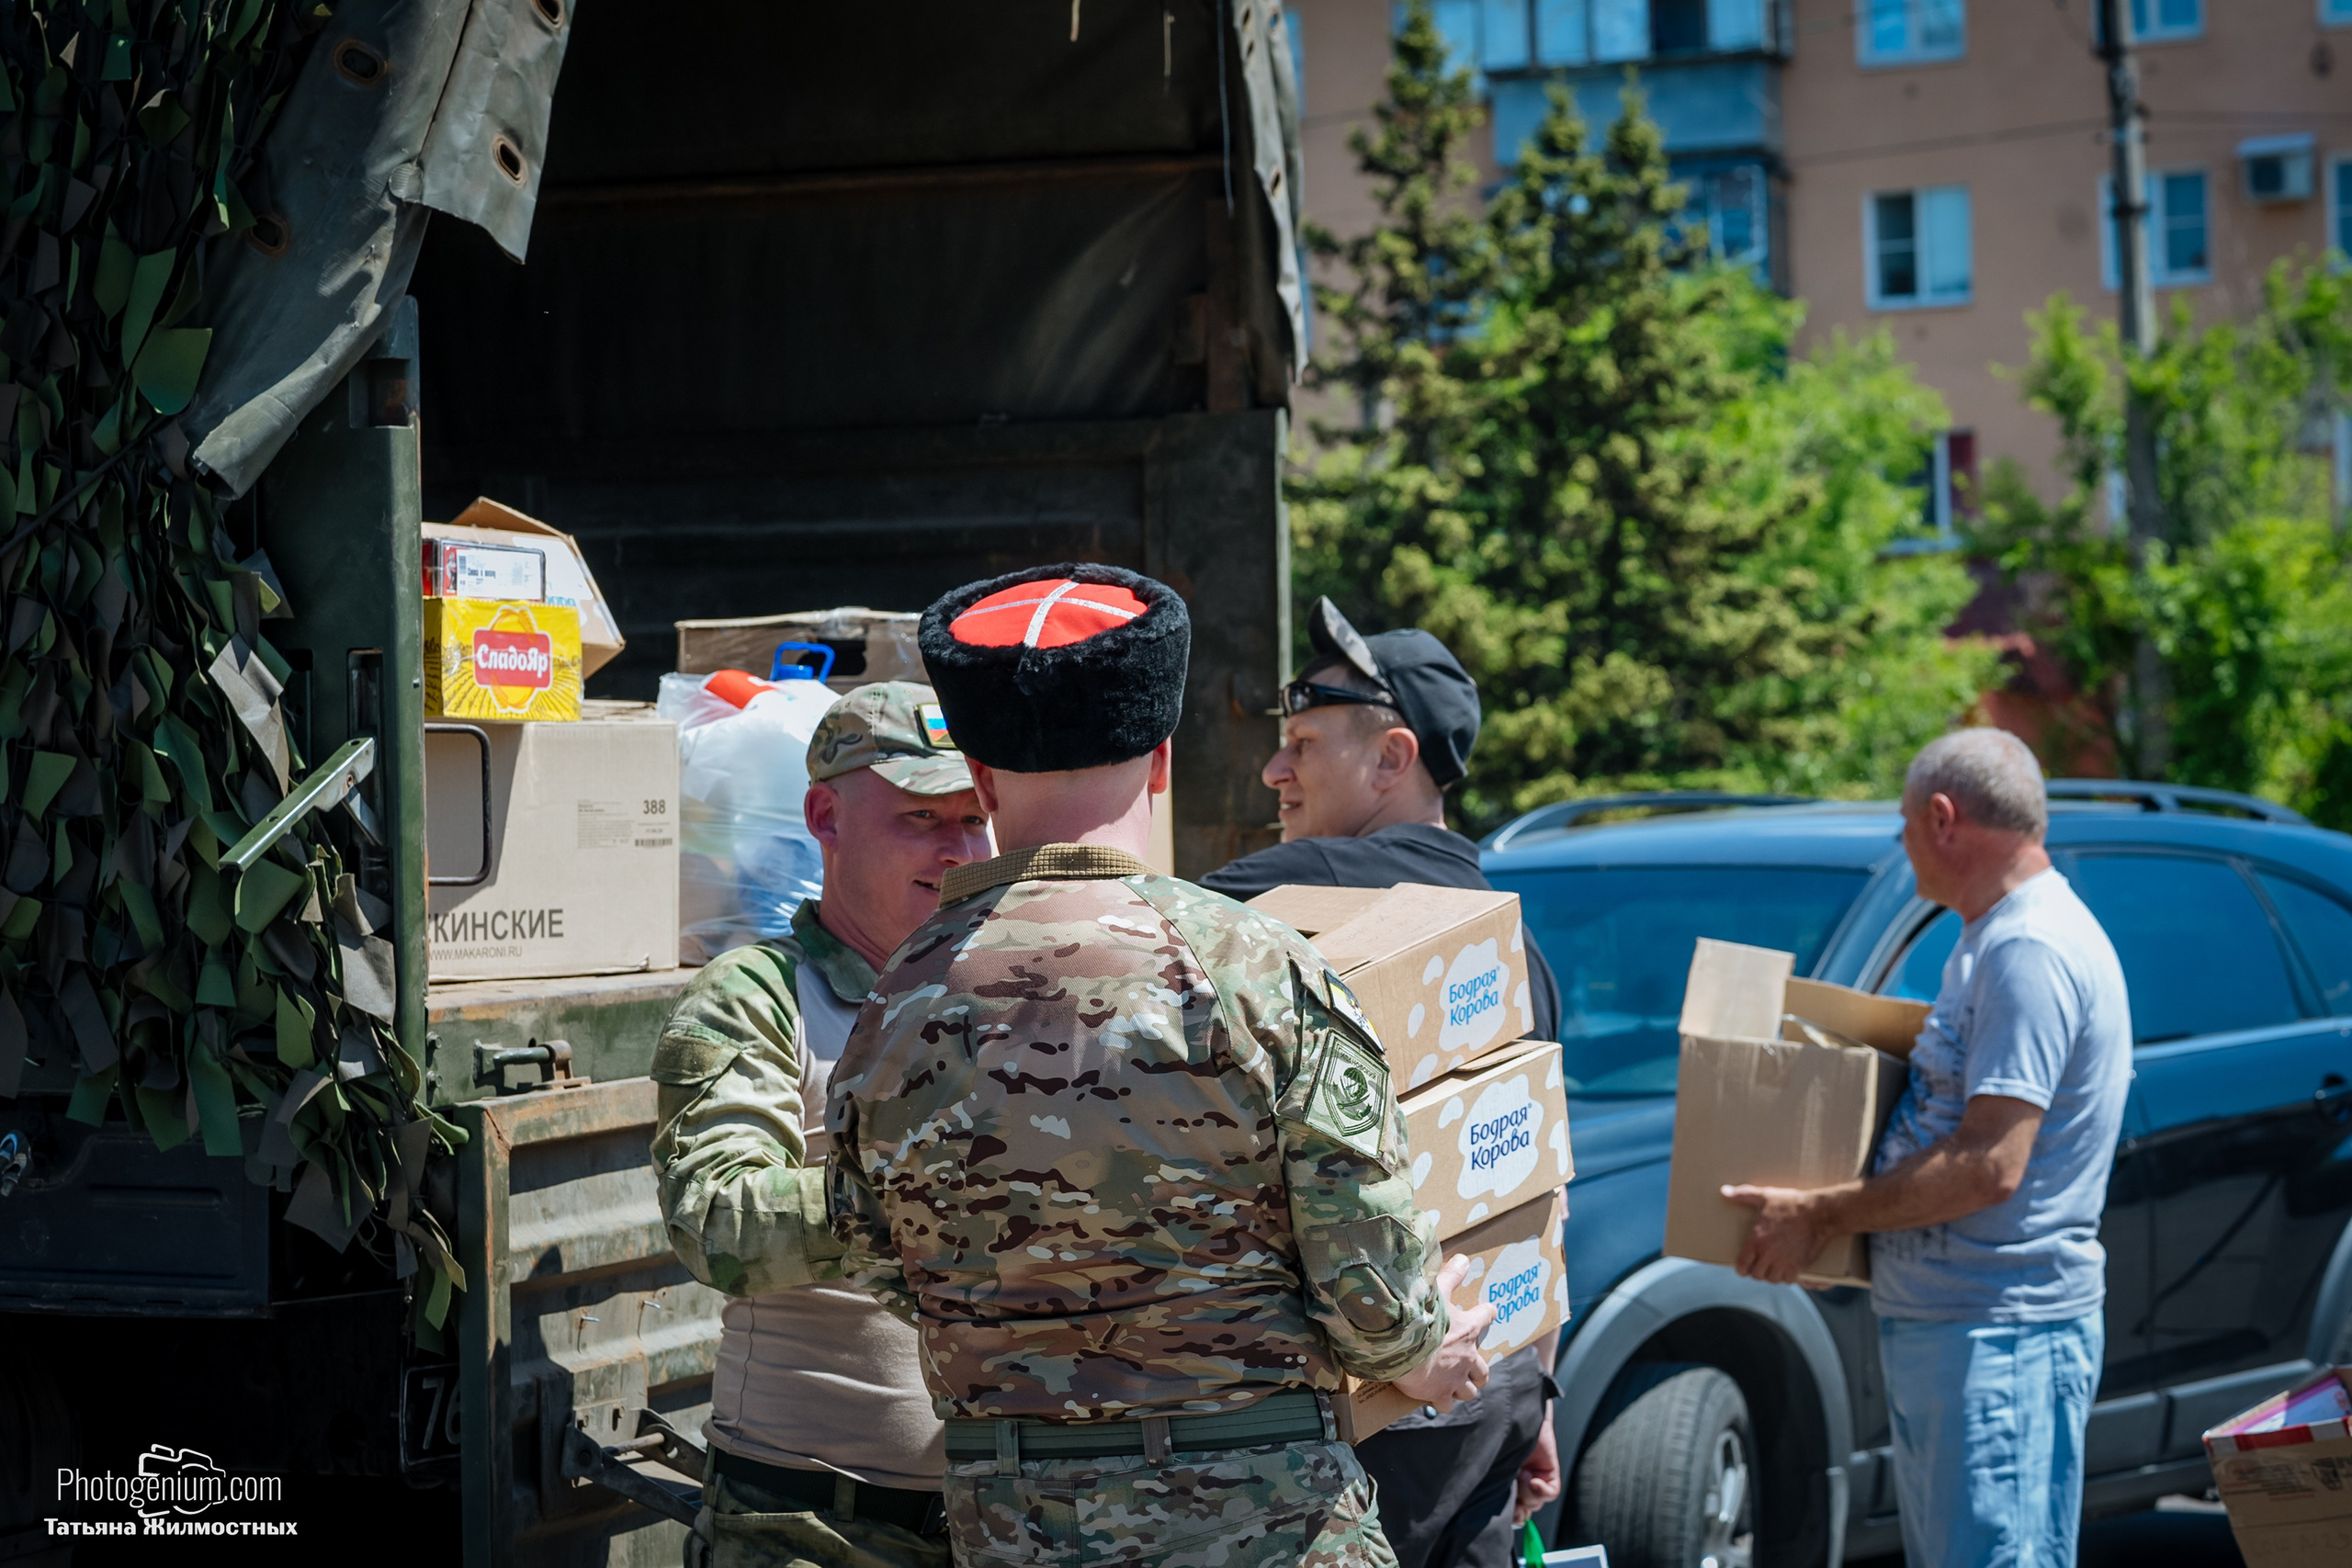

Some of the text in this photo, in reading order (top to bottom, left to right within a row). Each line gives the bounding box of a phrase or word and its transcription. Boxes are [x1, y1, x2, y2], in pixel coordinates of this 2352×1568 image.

[476, 643, 548, 678] СладоЯр
[643, 799, 666, 815] 388
[428, 908, 564, 943] КИНСКИЕ
[1449, 968, 1498, 1004] Бодрая
[1449, 988, 1498, 1026] Корова
[1470, 1106, 1528, 1145] Бодрая
[1471, 1128, 1530, 1171] Корова
[1488, 1265, 1538, 1303] Бодрая
